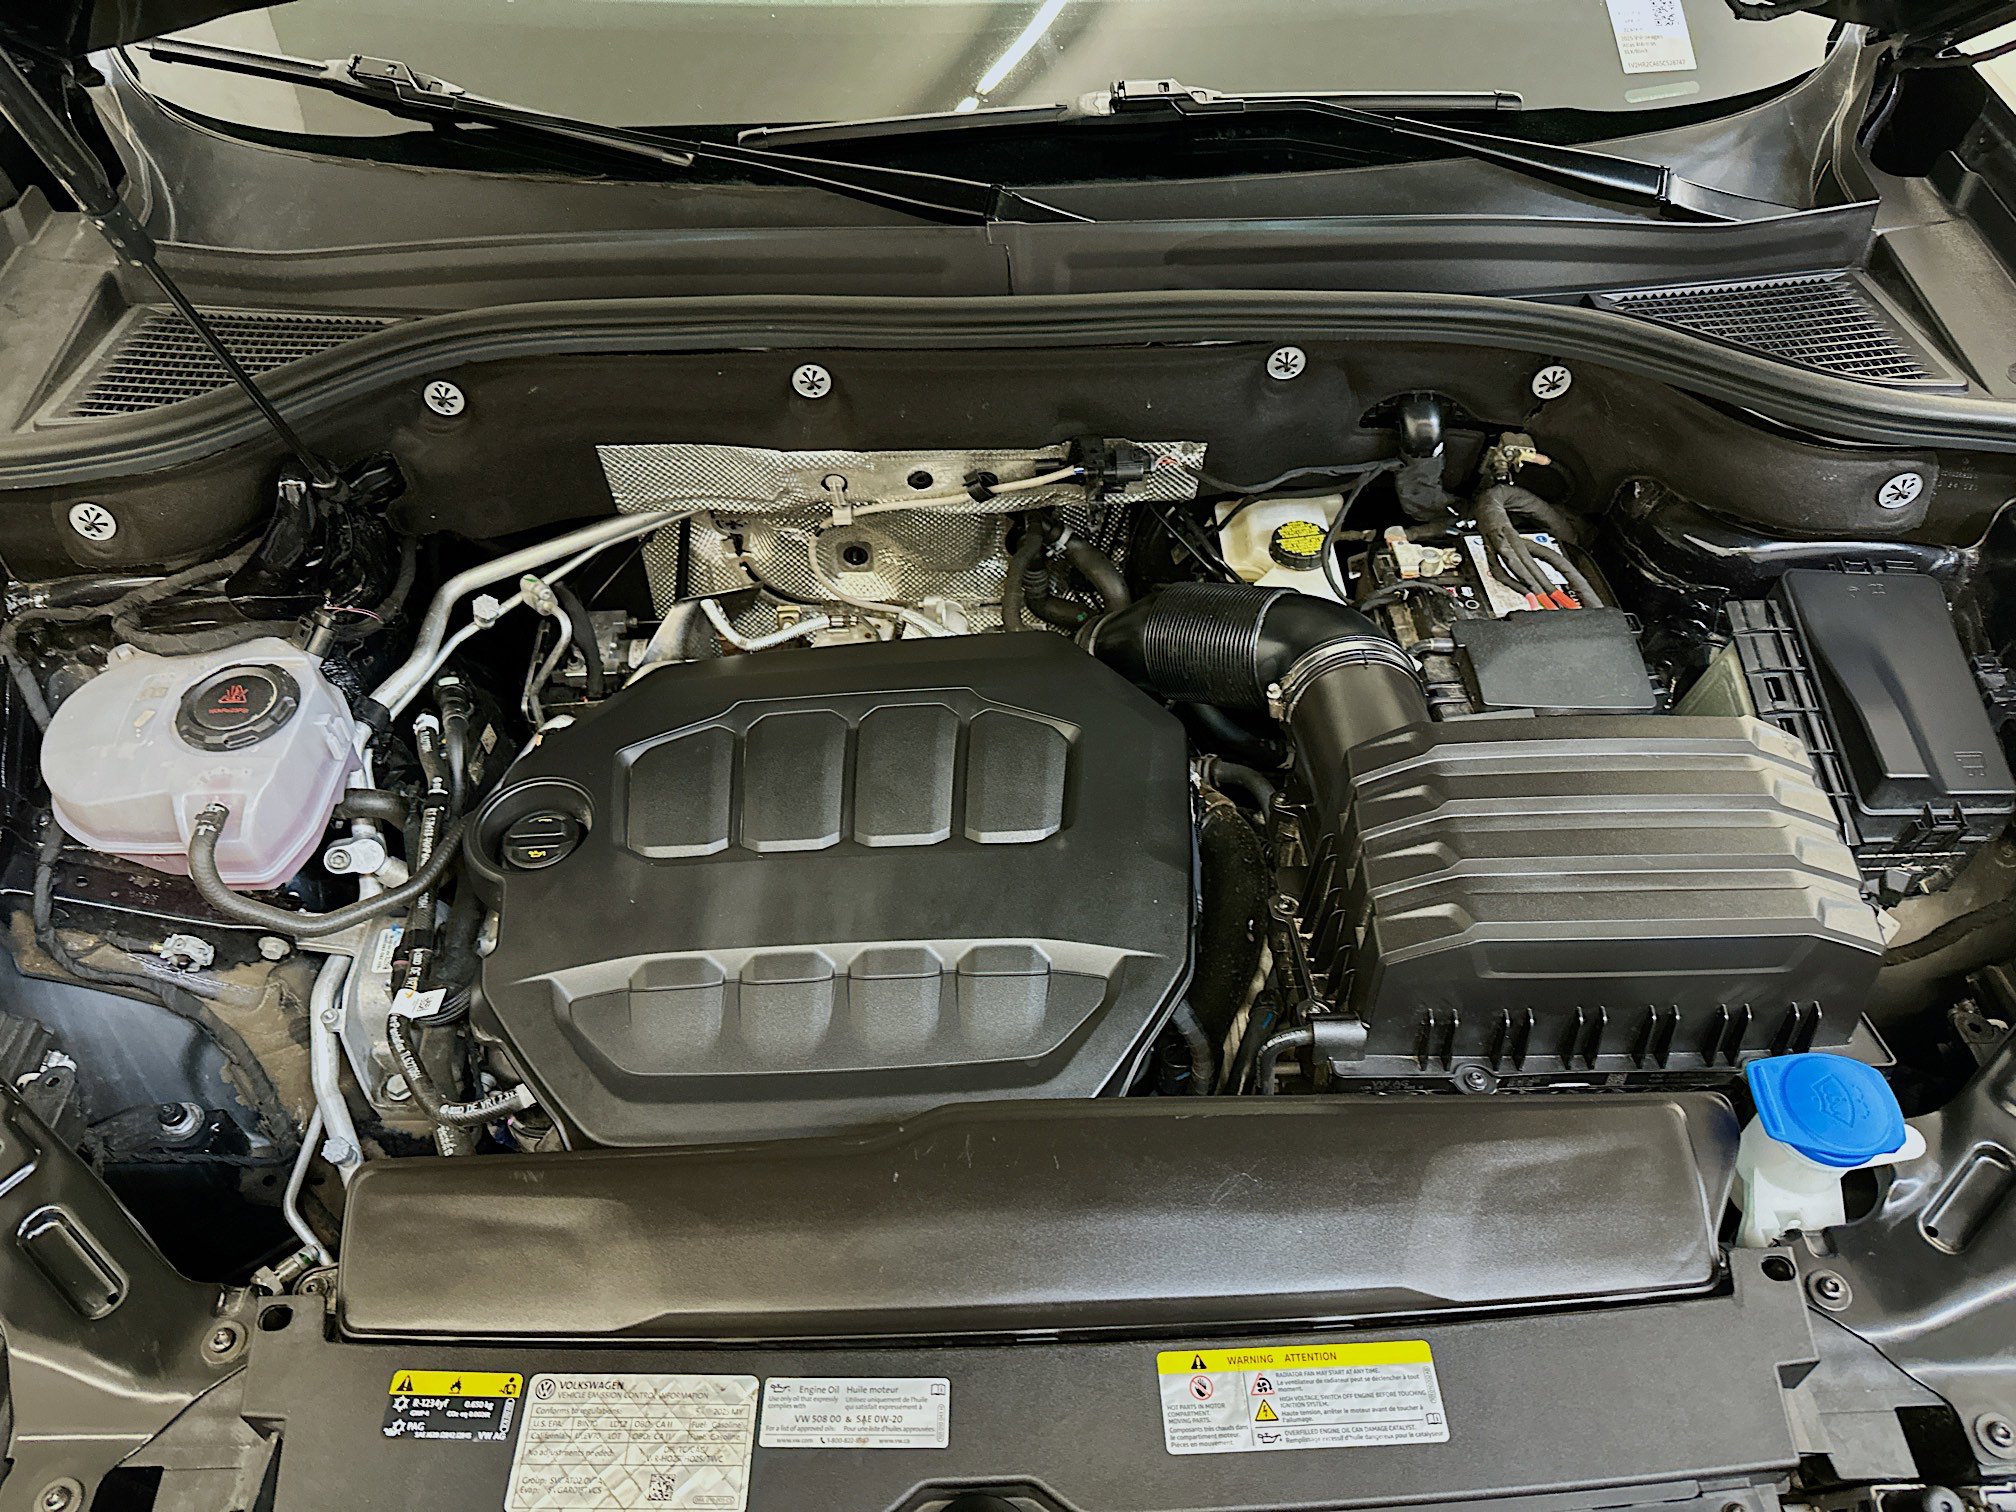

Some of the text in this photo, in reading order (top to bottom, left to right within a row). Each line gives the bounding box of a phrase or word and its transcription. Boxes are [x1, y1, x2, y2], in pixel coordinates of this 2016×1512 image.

[1227, 1352, 1337, 1365] WARNING ATTENTION
[559, 1381, 624, 1389] VOLKSWAGEN
[800, 1386, 826, 1395] Engine
[624, 1392, 655, 1400] CONTROL
[857, 1415, 872, 1423] SAE
[875, 1415, 903, 1423] 0W-20
[1177, 1433, 1217, 1441] compartiment
